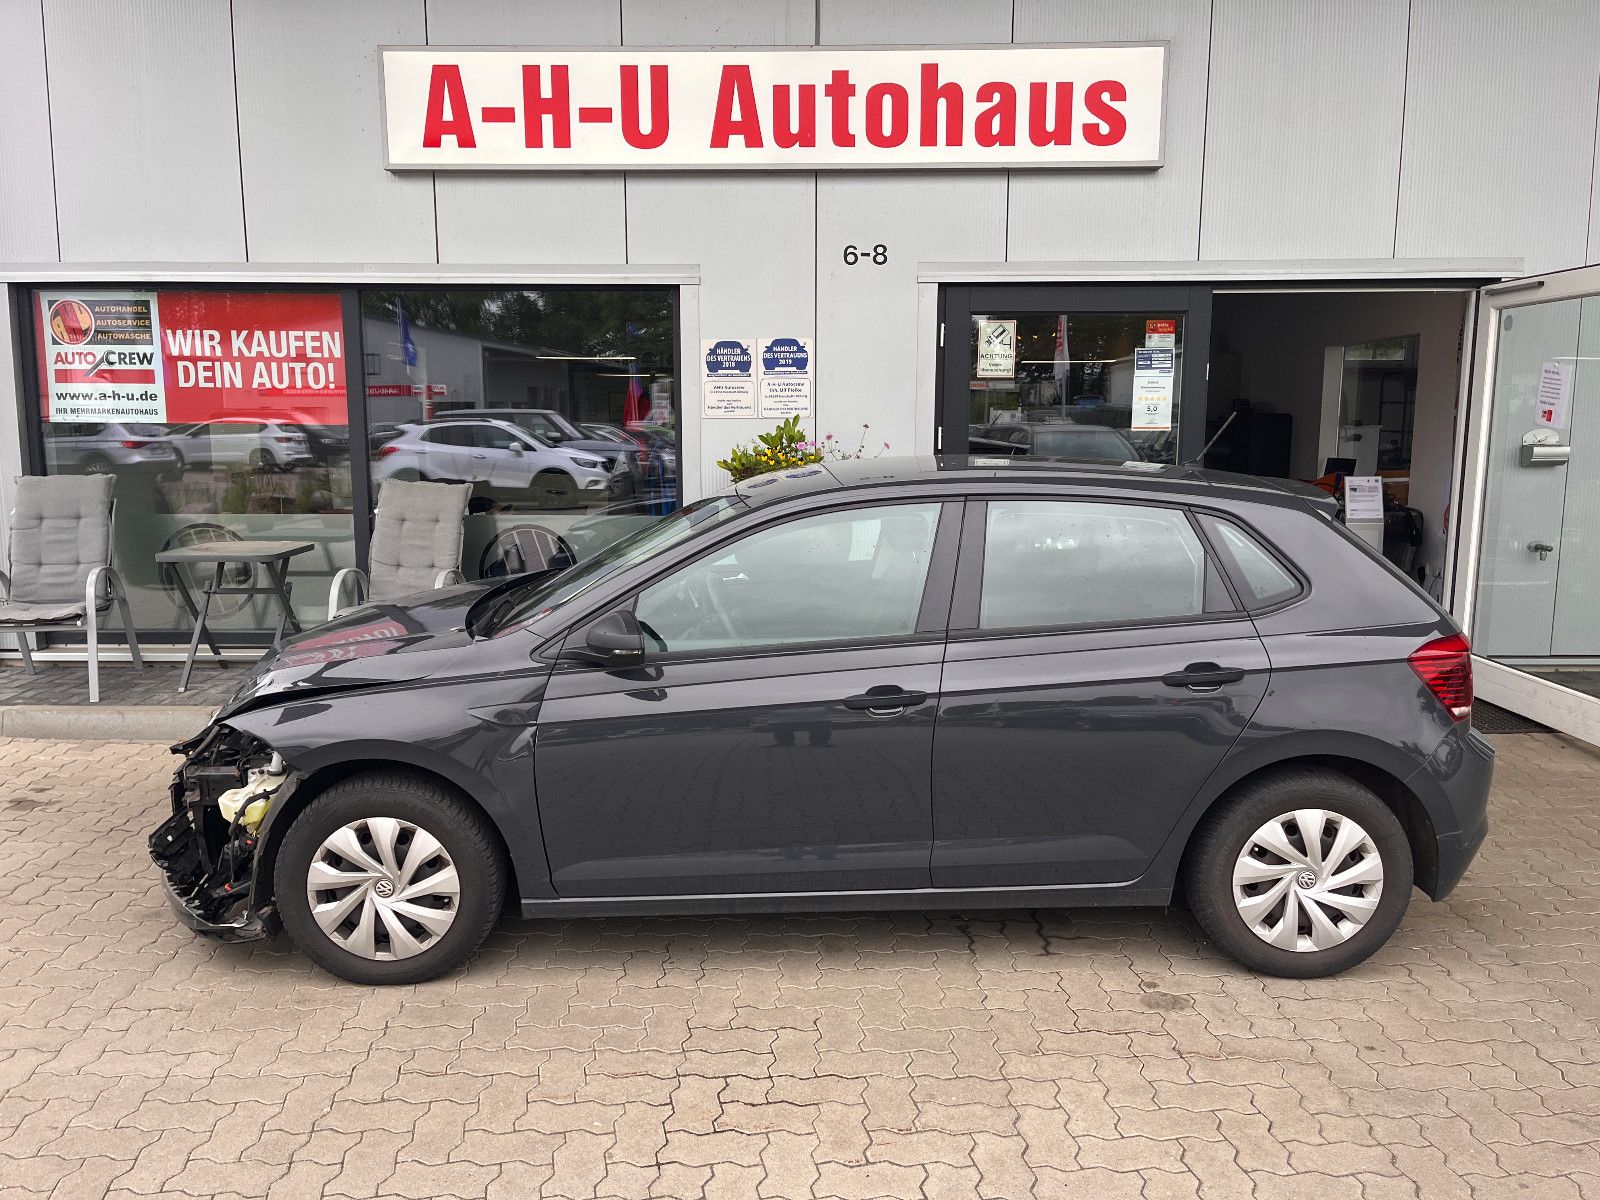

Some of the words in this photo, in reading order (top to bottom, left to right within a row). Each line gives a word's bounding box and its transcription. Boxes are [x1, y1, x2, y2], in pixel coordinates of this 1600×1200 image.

[422, 64, 670, 150] A-H-U
[709, 62, 1128, 150] Autohaus
[843, 244, 888, 266] 6-8
[94, 305, 148, 313] AUTOHANDEL
[95, 319, 151, 327] AUTOSERVICE
[165, 329, 223, 357] WIR
[230, 329, 342, 359] KAUFEN
[716, 346, 741, 355] HÄNDLER
[53, 351, 97, 365] AUTO
[104, 350, 155, 366] CREW
[706, 354, 717, 362] DES
[177, 360, 243, 389] DEIN
[251, 361, 336, 390] AUTO!
[55, 390, 158, 402] www.a-h-u.de
[55, 407, 68, 415] IHR
[69, 407, 159, 416] MEHRMARKENAUTOHAUS
